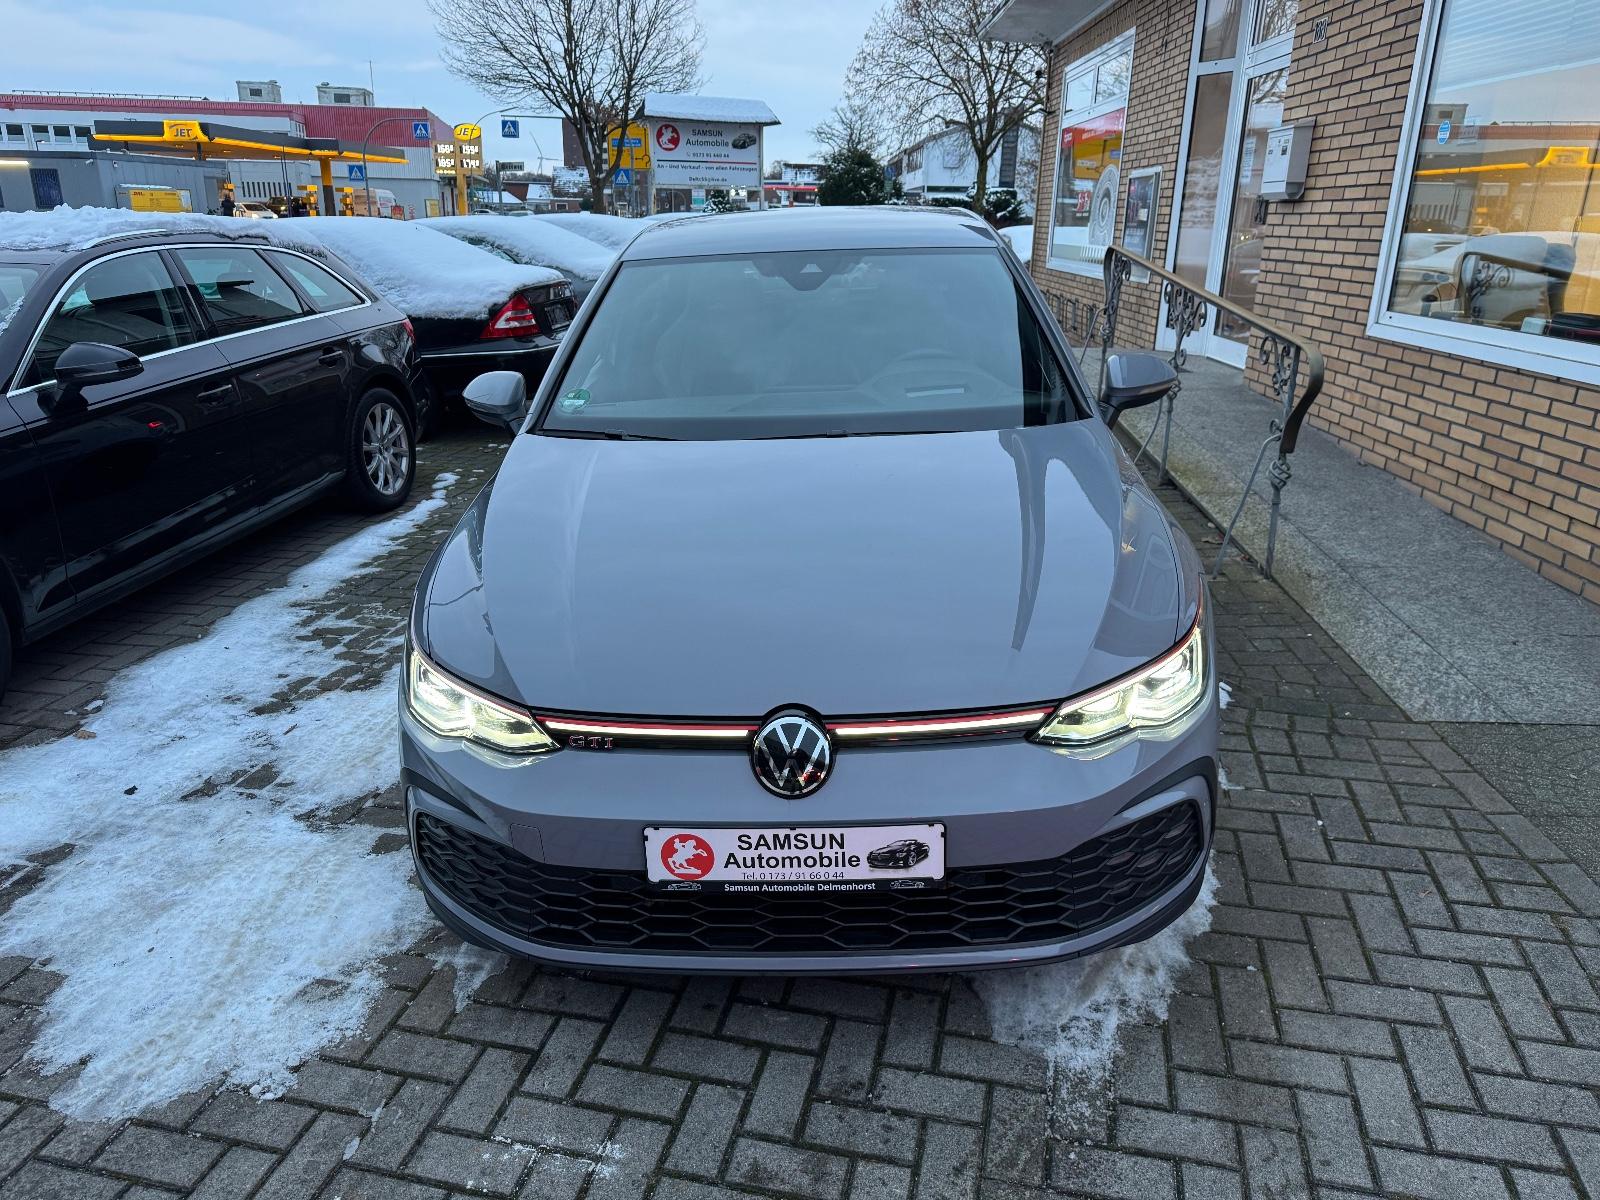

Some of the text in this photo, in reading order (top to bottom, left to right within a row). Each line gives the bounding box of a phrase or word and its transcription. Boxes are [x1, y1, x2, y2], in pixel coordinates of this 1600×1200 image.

[174, 128, 192, 137] JET
[457, 127, 477, 136] JET
[691, 129, 723, 137] SAMSUN
[685, 139, 729, 147] Automobile
[569, 735, 614, 749] GTI
[737, 833, 845, 851] SAMSUN
[723, 851, 861, 869] Automobile
[768, 872, 786, 880] 173
[795, 872, 807, 880] 91
[809, 871, 822, 880] 66
[823, 871, 830, 880] 0
[832, 871, 845, 880] 44
[724, 882, 876, 892] Samsun Automobile Delmenhorst
